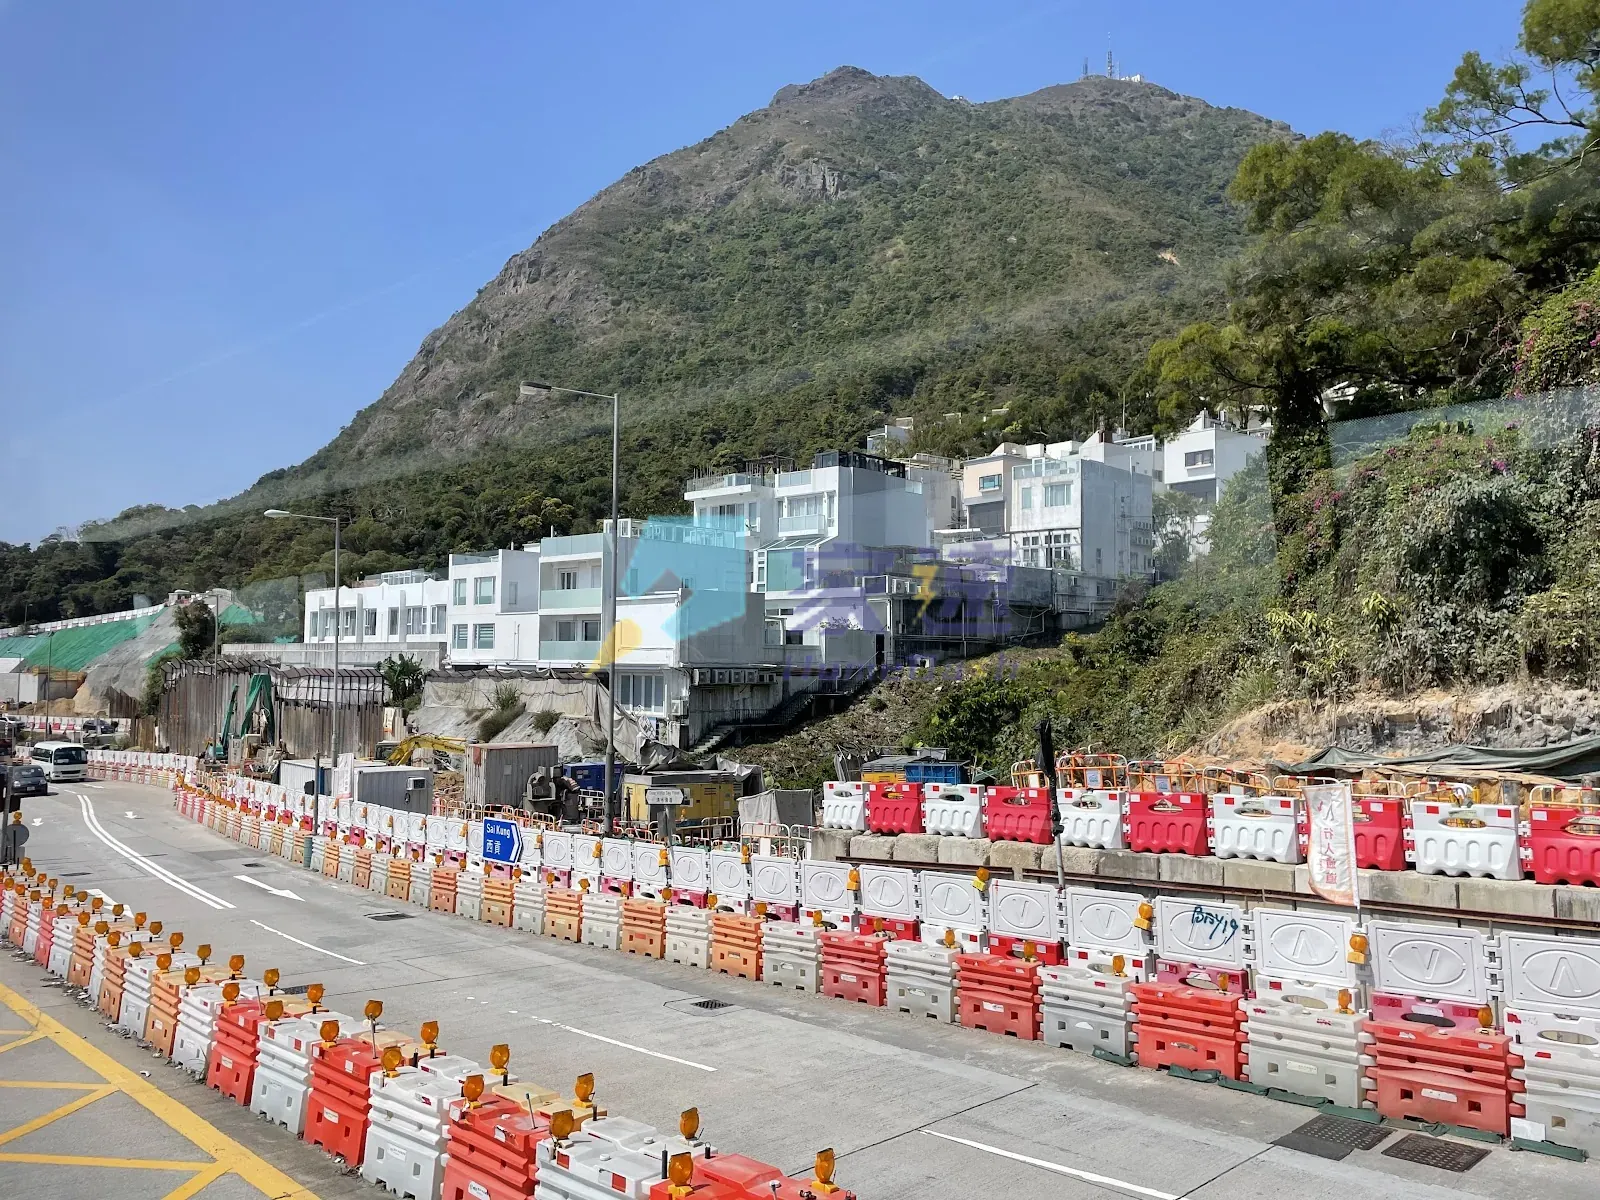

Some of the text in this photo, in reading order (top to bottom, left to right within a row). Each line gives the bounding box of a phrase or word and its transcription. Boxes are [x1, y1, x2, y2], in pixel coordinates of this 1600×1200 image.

[486, 823, 511, 839] Sai Kung
[486, 839, 501, 855] 西貢
